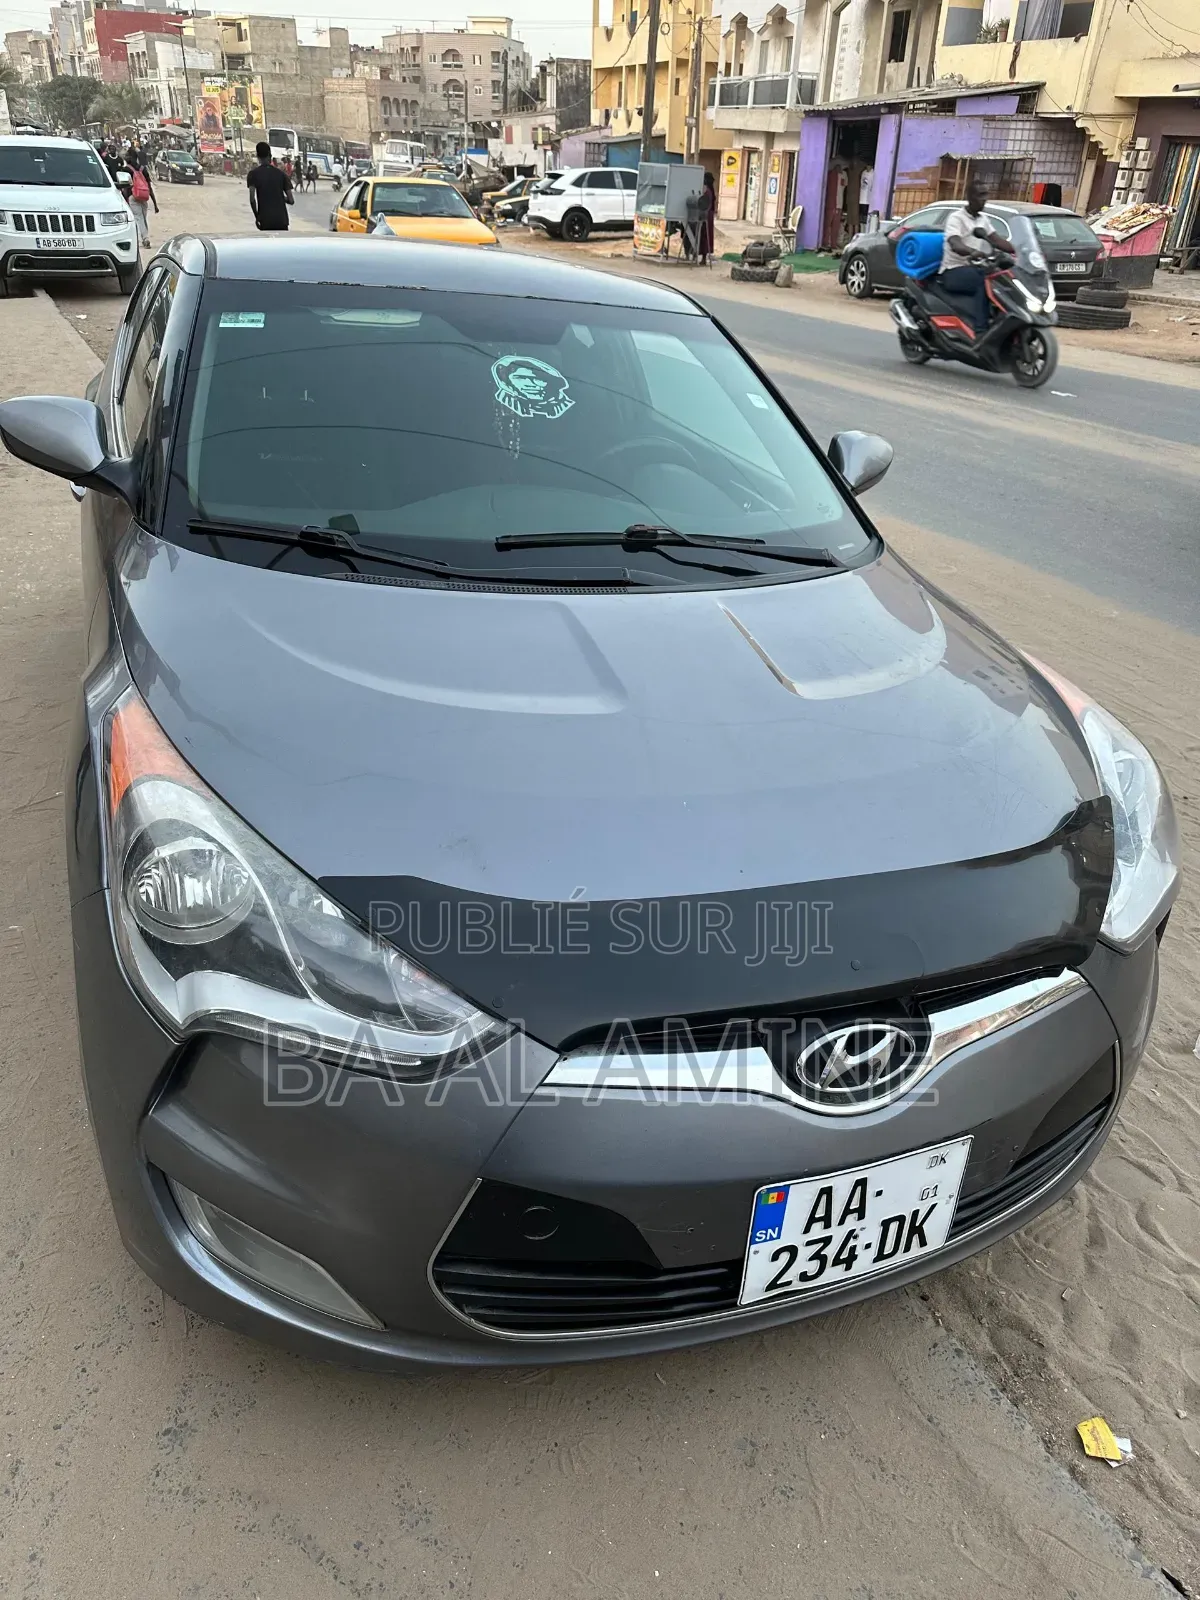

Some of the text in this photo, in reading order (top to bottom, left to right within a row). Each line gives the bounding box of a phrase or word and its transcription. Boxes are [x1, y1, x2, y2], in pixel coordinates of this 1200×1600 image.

[42, 239, 51, 247] AB
[926, 1150, 950, 1170] DK
[919, 1184, 939, 1202] 01
[754, 1227, 779, 1242] SN
